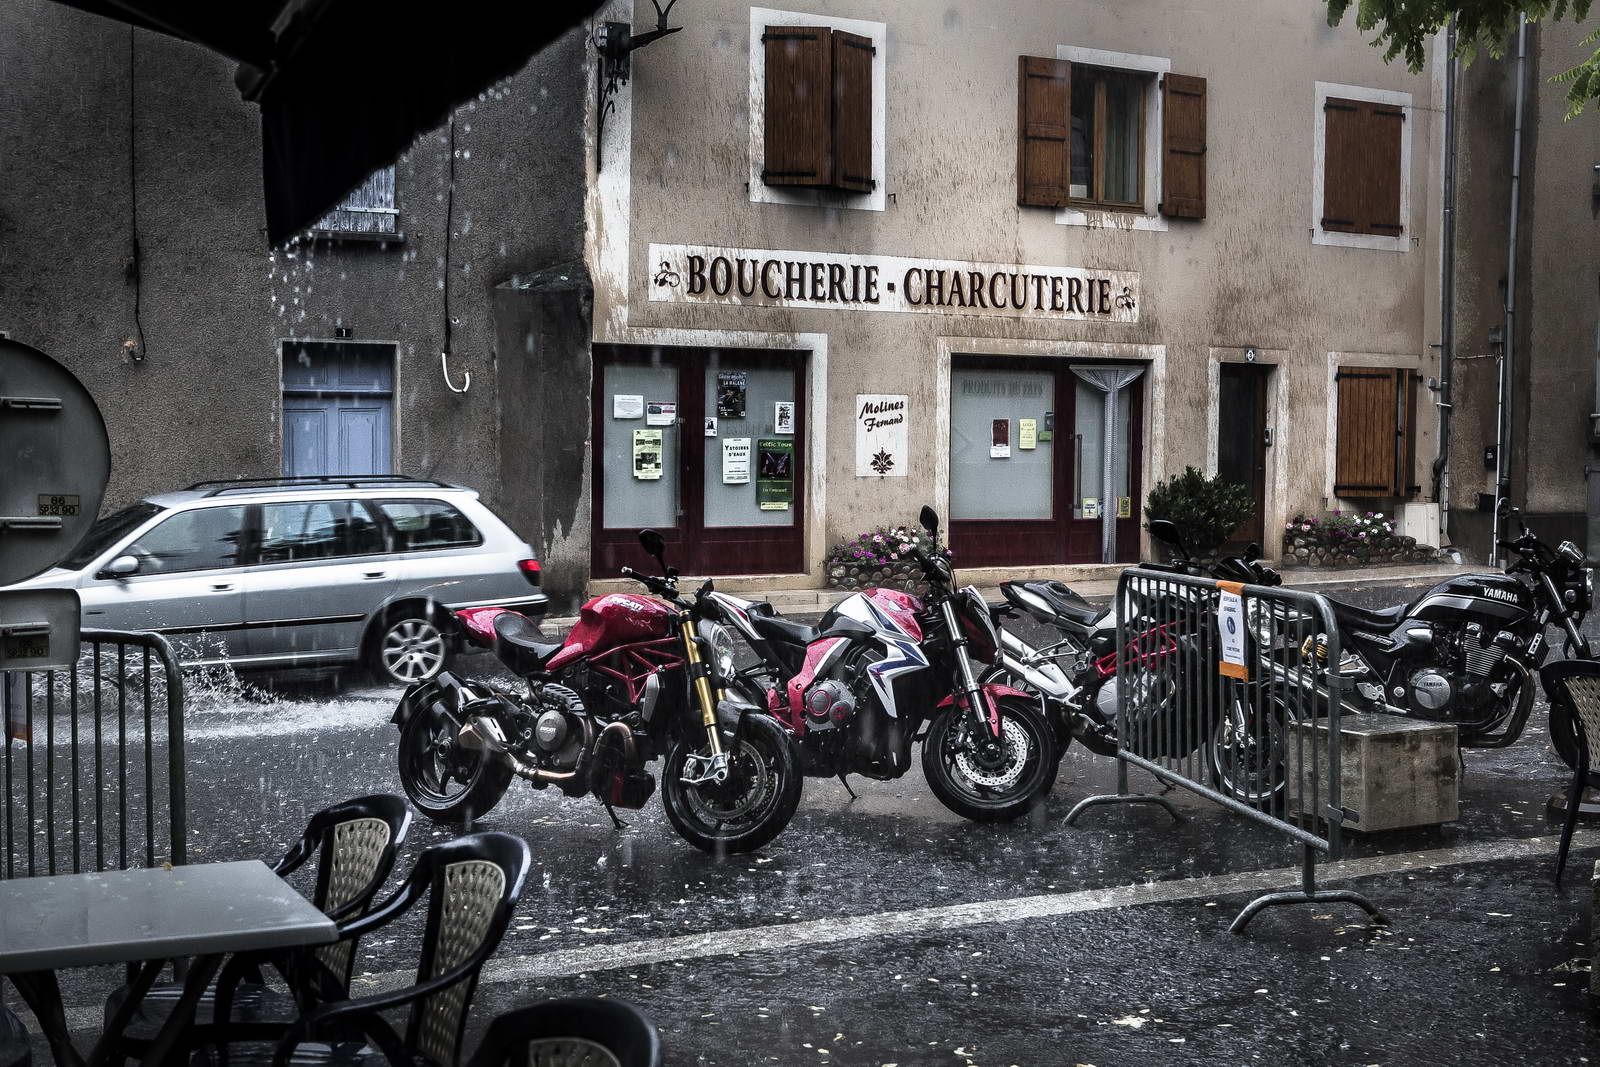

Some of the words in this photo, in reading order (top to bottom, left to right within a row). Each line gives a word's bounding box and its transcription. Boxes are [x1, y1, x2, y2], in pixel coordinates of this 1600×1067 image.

[687, 255, 880, 303] BOUCHERIE
[903, 267, 1112, 314] CHARCUTERIE
[859, 400, 904, 419] Molines
[864, 413, 903, 432] Fernand
[51, 496, 65, 505] 86
[1483, 587, 1519, 603] YAMAHA
[610, 596, 645, 612] DUCATI
[30, 647, 44, 657] 90
